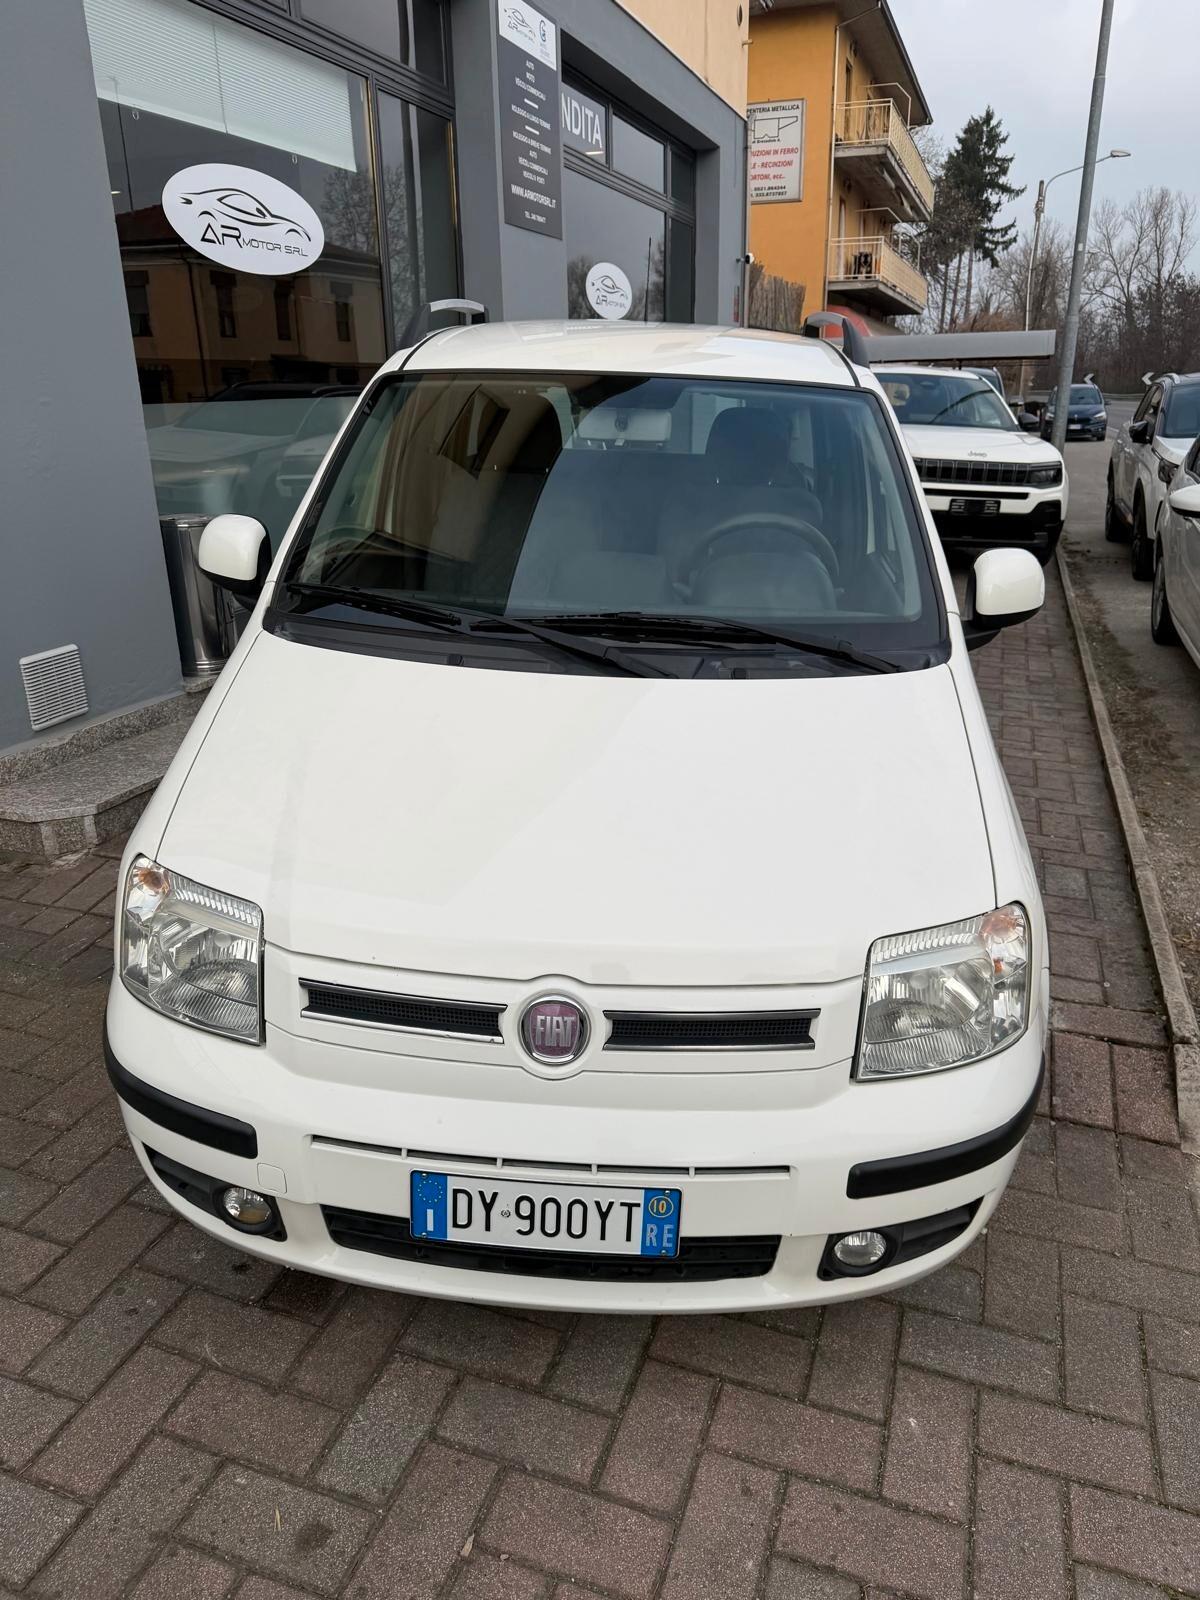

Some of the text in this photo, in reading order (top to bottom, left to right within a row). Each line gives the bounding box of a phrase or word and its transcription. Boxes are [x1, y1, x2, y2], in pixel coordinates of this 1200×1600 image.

[771, 104, 800, 112] METALLICA
[561, 92, 602, 149] NDITA
[780, 147, 799, 155] FERRO
[760, 160, 794, 169] RECINZIONI
[242, 237, 281, 252] MOTOR
[535, 1015, 576, 1047] FIAT
[645, 1223, 674, 1248] RE
